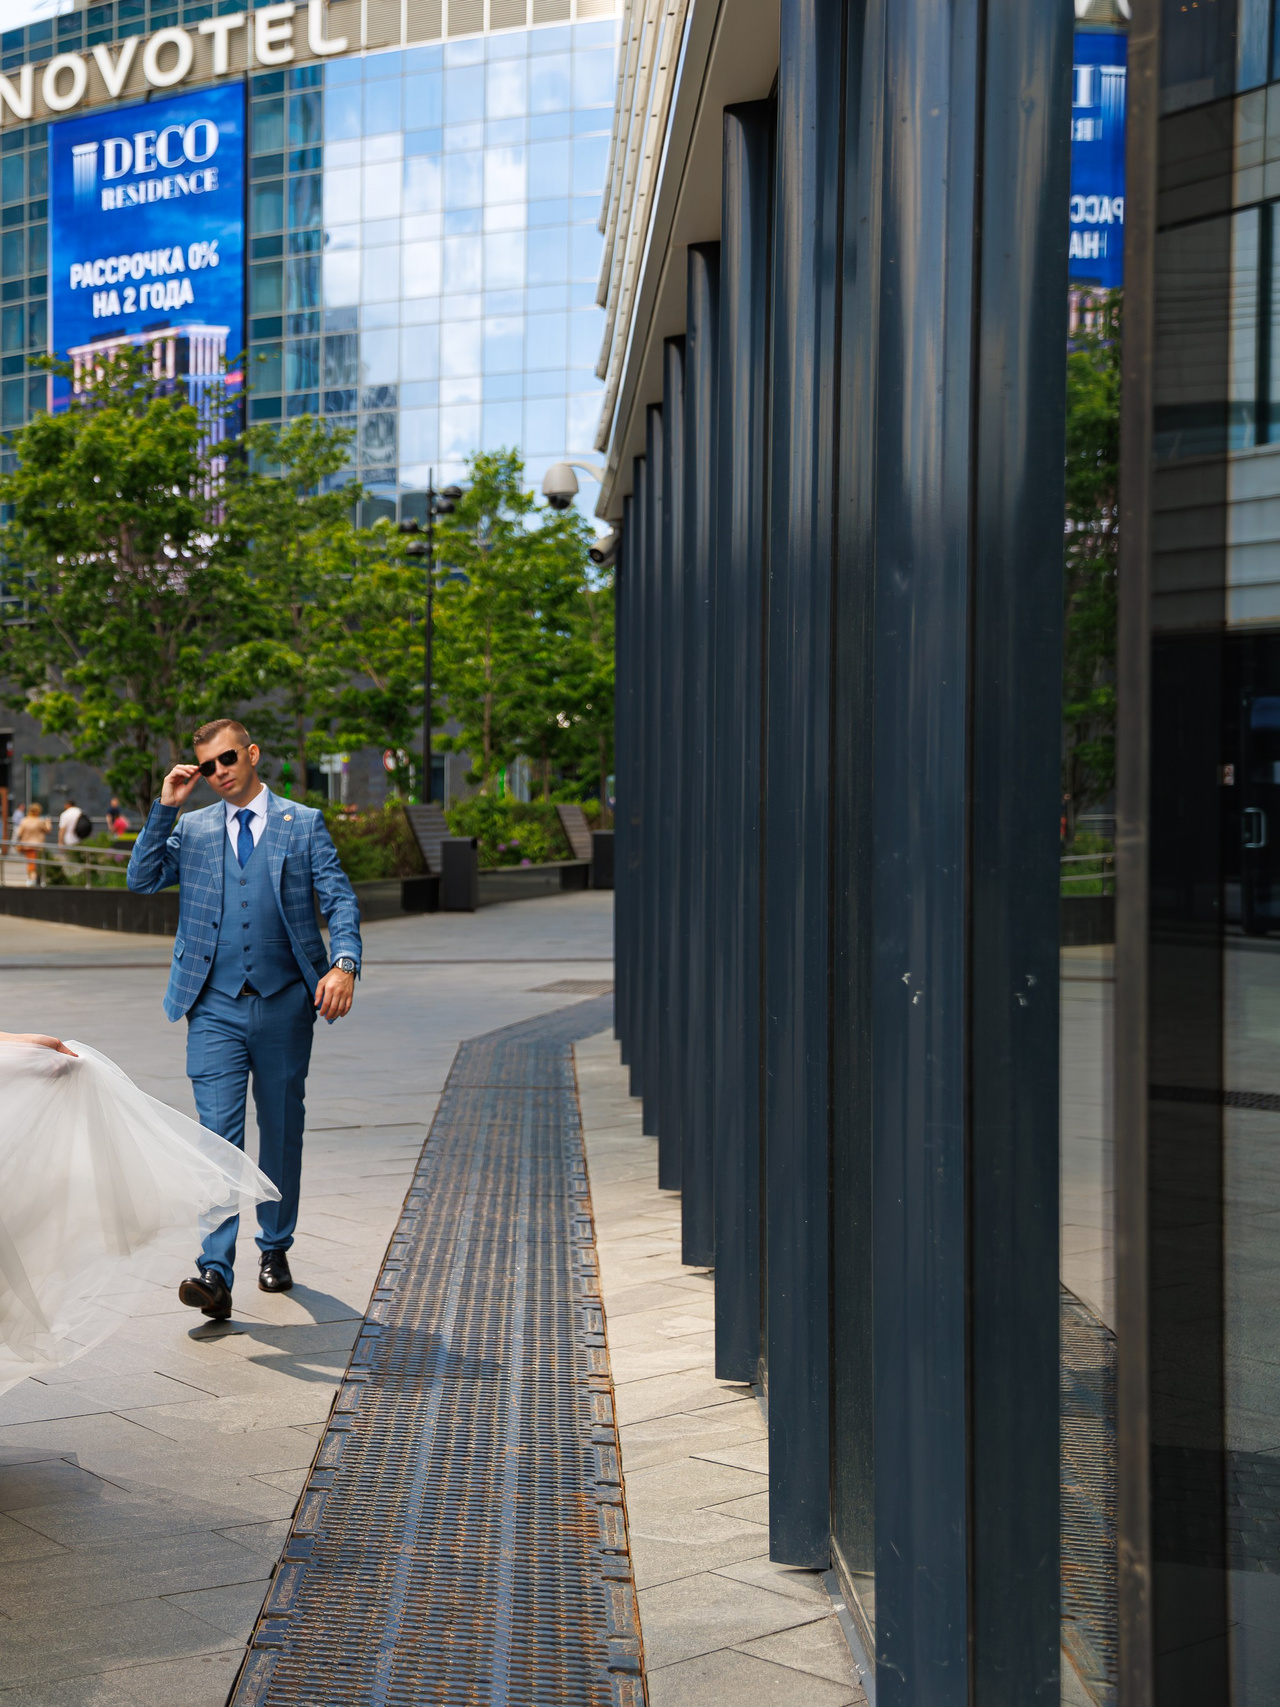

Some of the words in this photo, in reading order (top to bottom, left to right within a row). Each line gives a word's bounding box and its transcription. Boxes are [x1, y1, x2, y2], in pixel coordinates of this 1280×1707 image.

[102, 118, 219, 181] DECO
[101, 166, 219, 211] RESIDENCE
[70, 245, 186, 290] РАССРОЧКА
[188, 238, 220, 271] 0%
[92, 289, 122, 319] НА
[123, 286, 138, 314] 2
[139, 277, 195, 312] ГОДА
